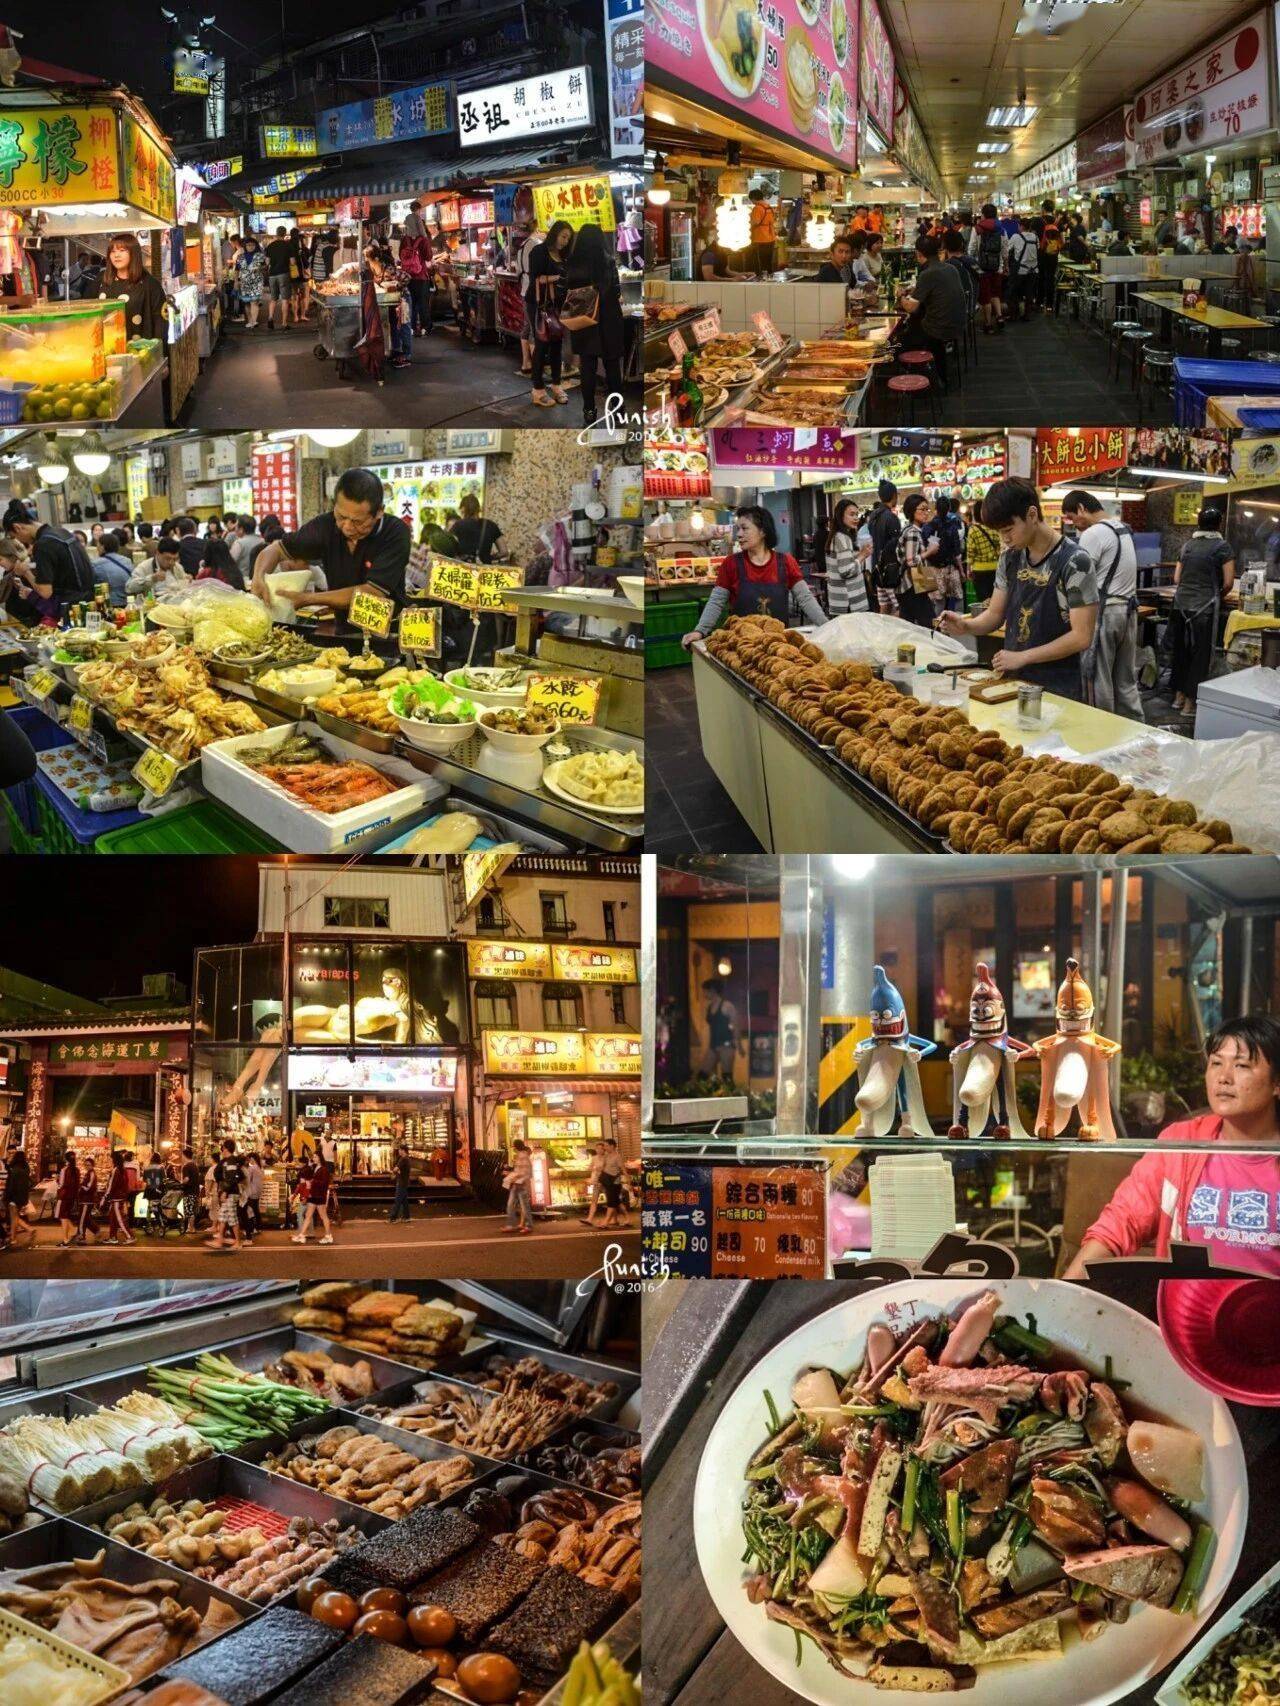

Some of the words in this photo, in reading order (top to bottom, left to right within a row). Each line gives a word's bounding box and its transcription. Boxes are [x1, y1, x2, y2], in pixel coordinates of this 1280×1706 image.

[767, 43, 779, 69] 50
[514, 73, 583, 107] 胡椒餅
[1224, 114, 1241, 136] 70
[88, 115, 114, 191] 柳橙
[52, 188, 65, 199] 30
[1041, 429, 1125, 465] 大餅包小餅
[645, 1169, 681, 1188] 唯一
[801, 1188, 813, 1206] 80
[691, 1236, 708, 1252] 90
[754, 1237, 766, 1253] 70
[716, 1252, 746, 1262] Cheese
